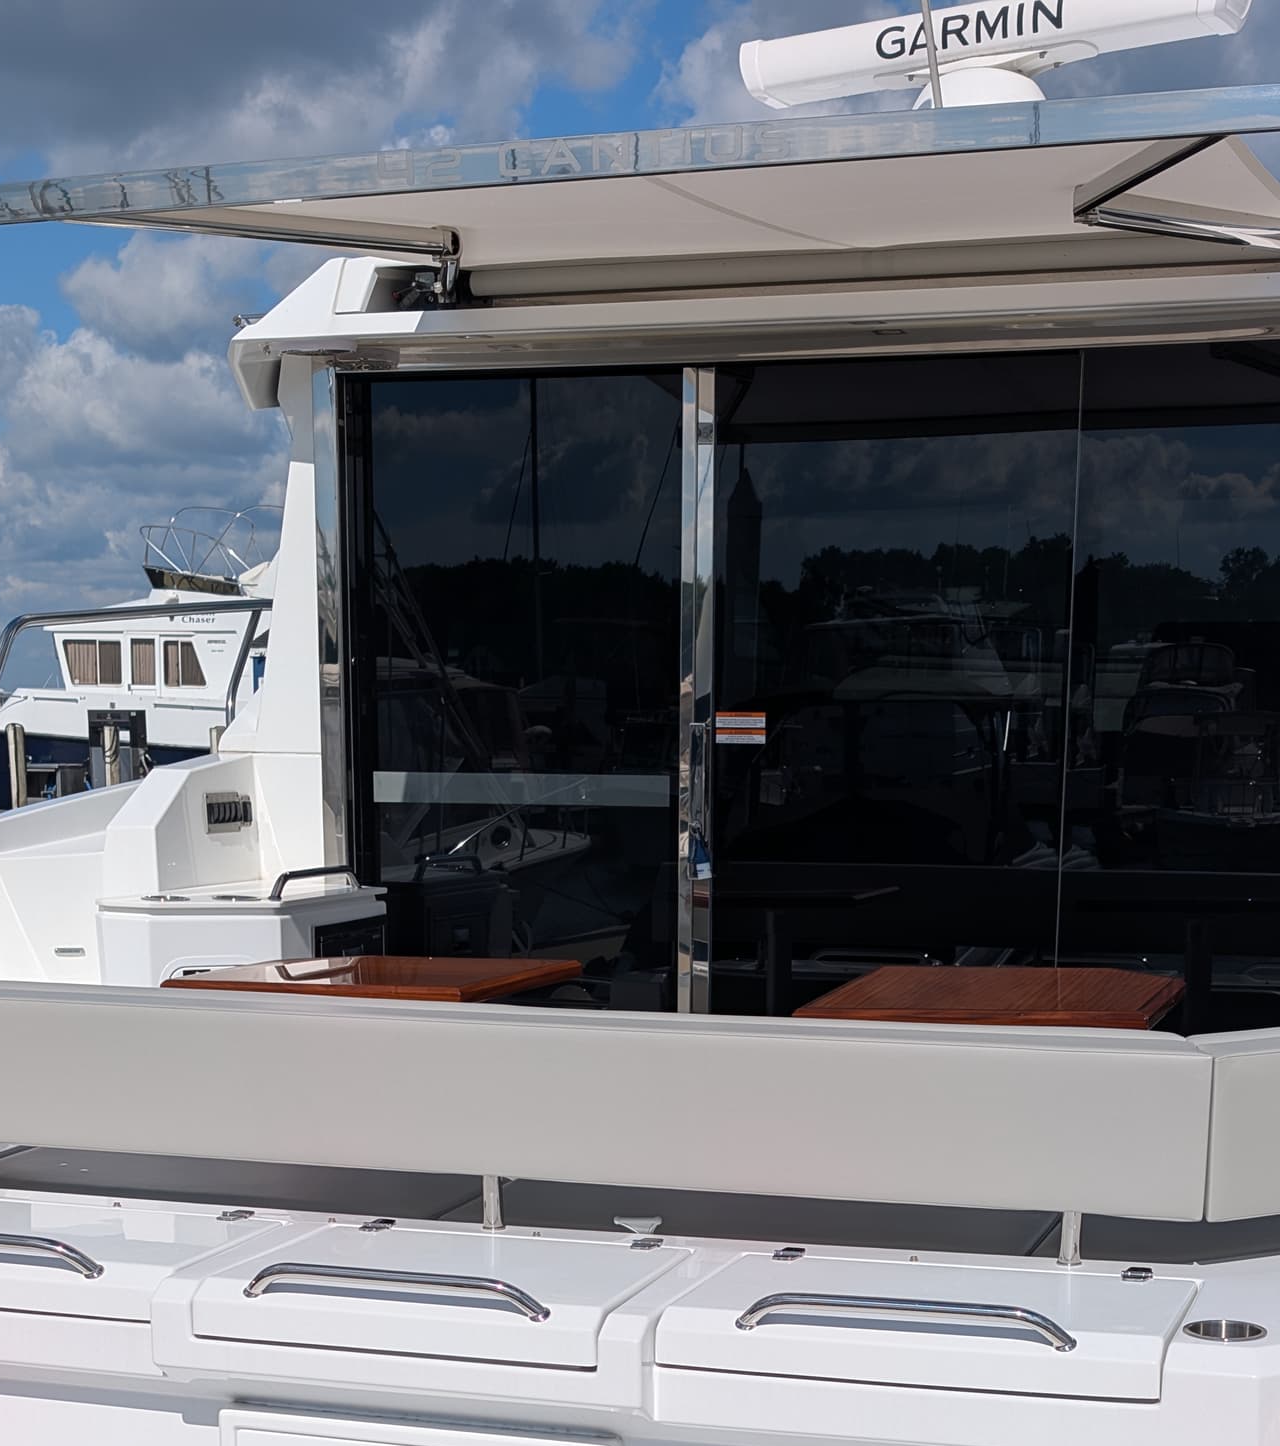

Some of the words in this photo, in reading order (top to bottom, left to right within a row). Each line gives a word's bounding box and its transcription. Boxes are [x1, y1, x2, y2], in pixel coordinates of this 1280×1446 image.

[876, 0, 1063, 60] GARMIN
[376, 149, 463, 186] 42
[499, 123, 791, 178] CANTIUS
[181, 615, 216, 624] Chaser
